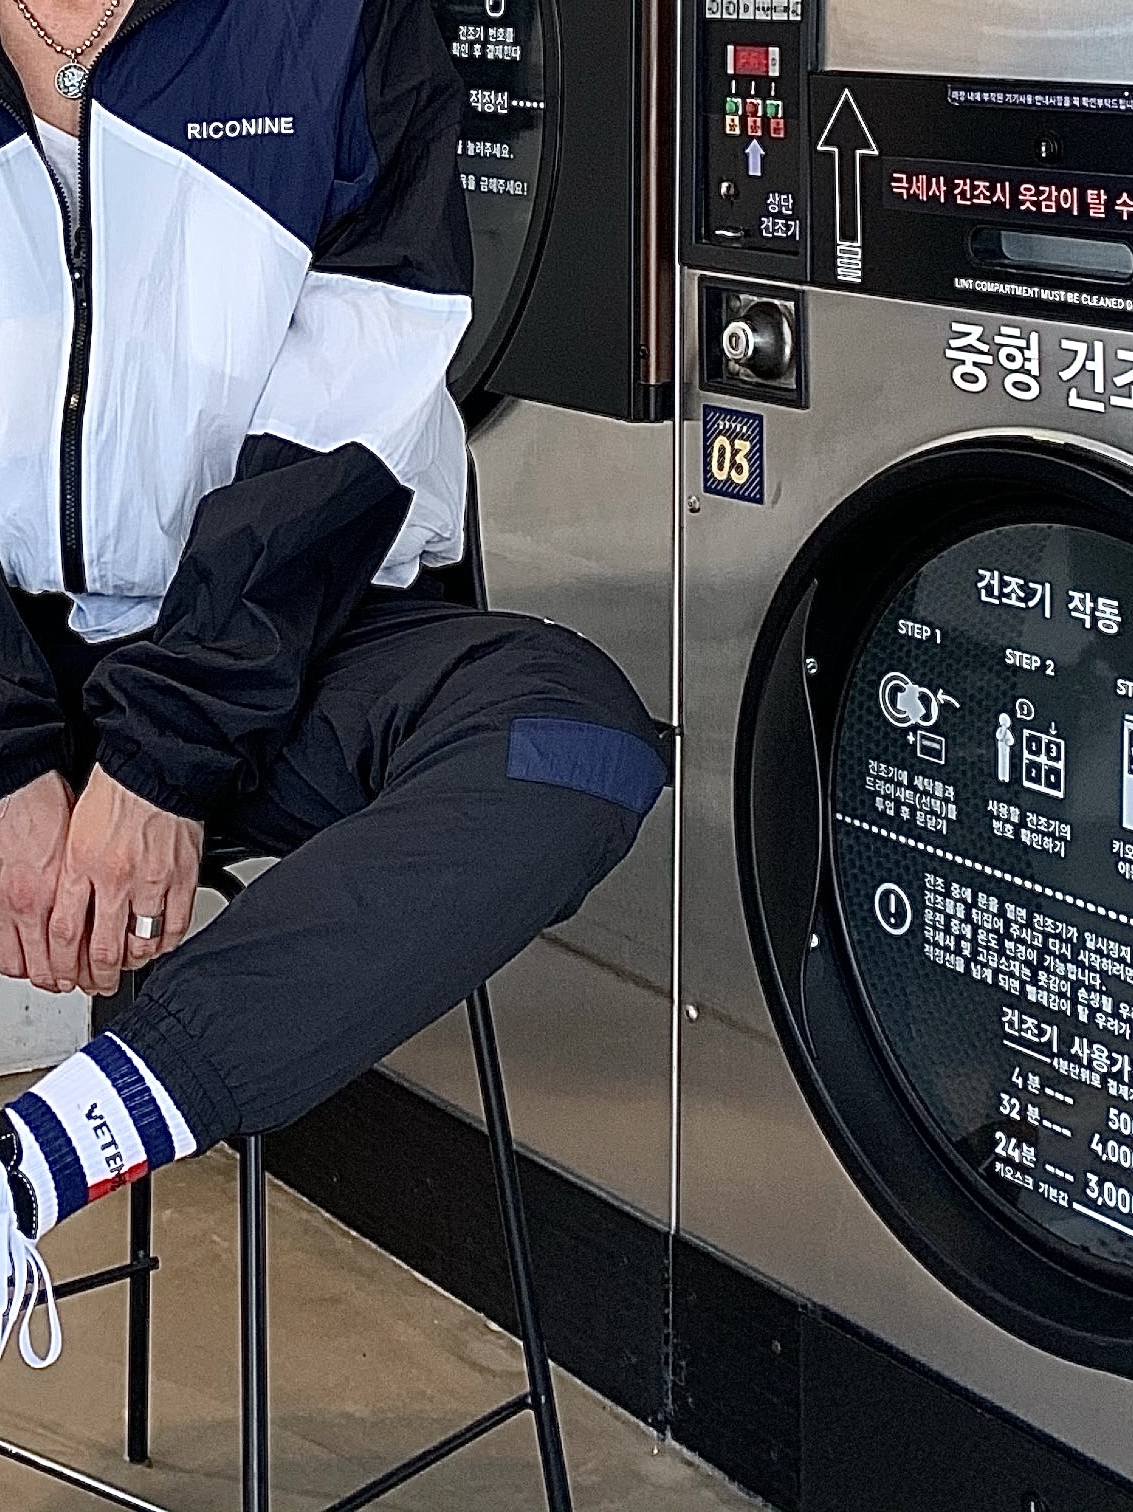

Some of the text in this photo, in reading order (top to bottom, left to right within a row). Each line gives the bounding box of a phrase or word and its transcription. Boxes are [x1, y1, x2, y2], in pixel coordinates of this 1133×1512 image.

[458, 25, 484, 41] 건조기
[469, 89, 509, 114] 적정선
[186, 116, 295, 140] RICONINE
[480, 176, 527, 196] 금해주세요!
[890, 172, 947, 204] 극세사
[953, 178, 1011, 209] 건조시
[1018, 183, 1079, 216] 옷감이
[1086, 189, 1107, 219] 탈
[766, 192, 794, 215] 상단
[760, 216, 800, 241] 건조기
[954, 277, 1125, 310] LINT COMPARTMENT MUST BE CLEANED
[944, 321, 1041, 402] 중형
[711, 434, 752, 484] 03
[976, 568, 1122, 635] 건조기 작동
[898, 619, 932, 640] STEP
[1004, 648, 1056, 676] STEP 2
[987, 799, 1071, 841] 사용할 건조기의
[992, 819, 1065, 858] 번호 확인하기
[1009, 922, 1043, 948] 주시고
[1048, 937, 1071, 960] 다시
[1033, 912, 1078, 943] 건조기가
[1043, 954, 1107, 991] 가능합니다.
[1001, 1006, 1058, 1053] 건조기
[994, 1161, 1034, 1190] 키오스크
